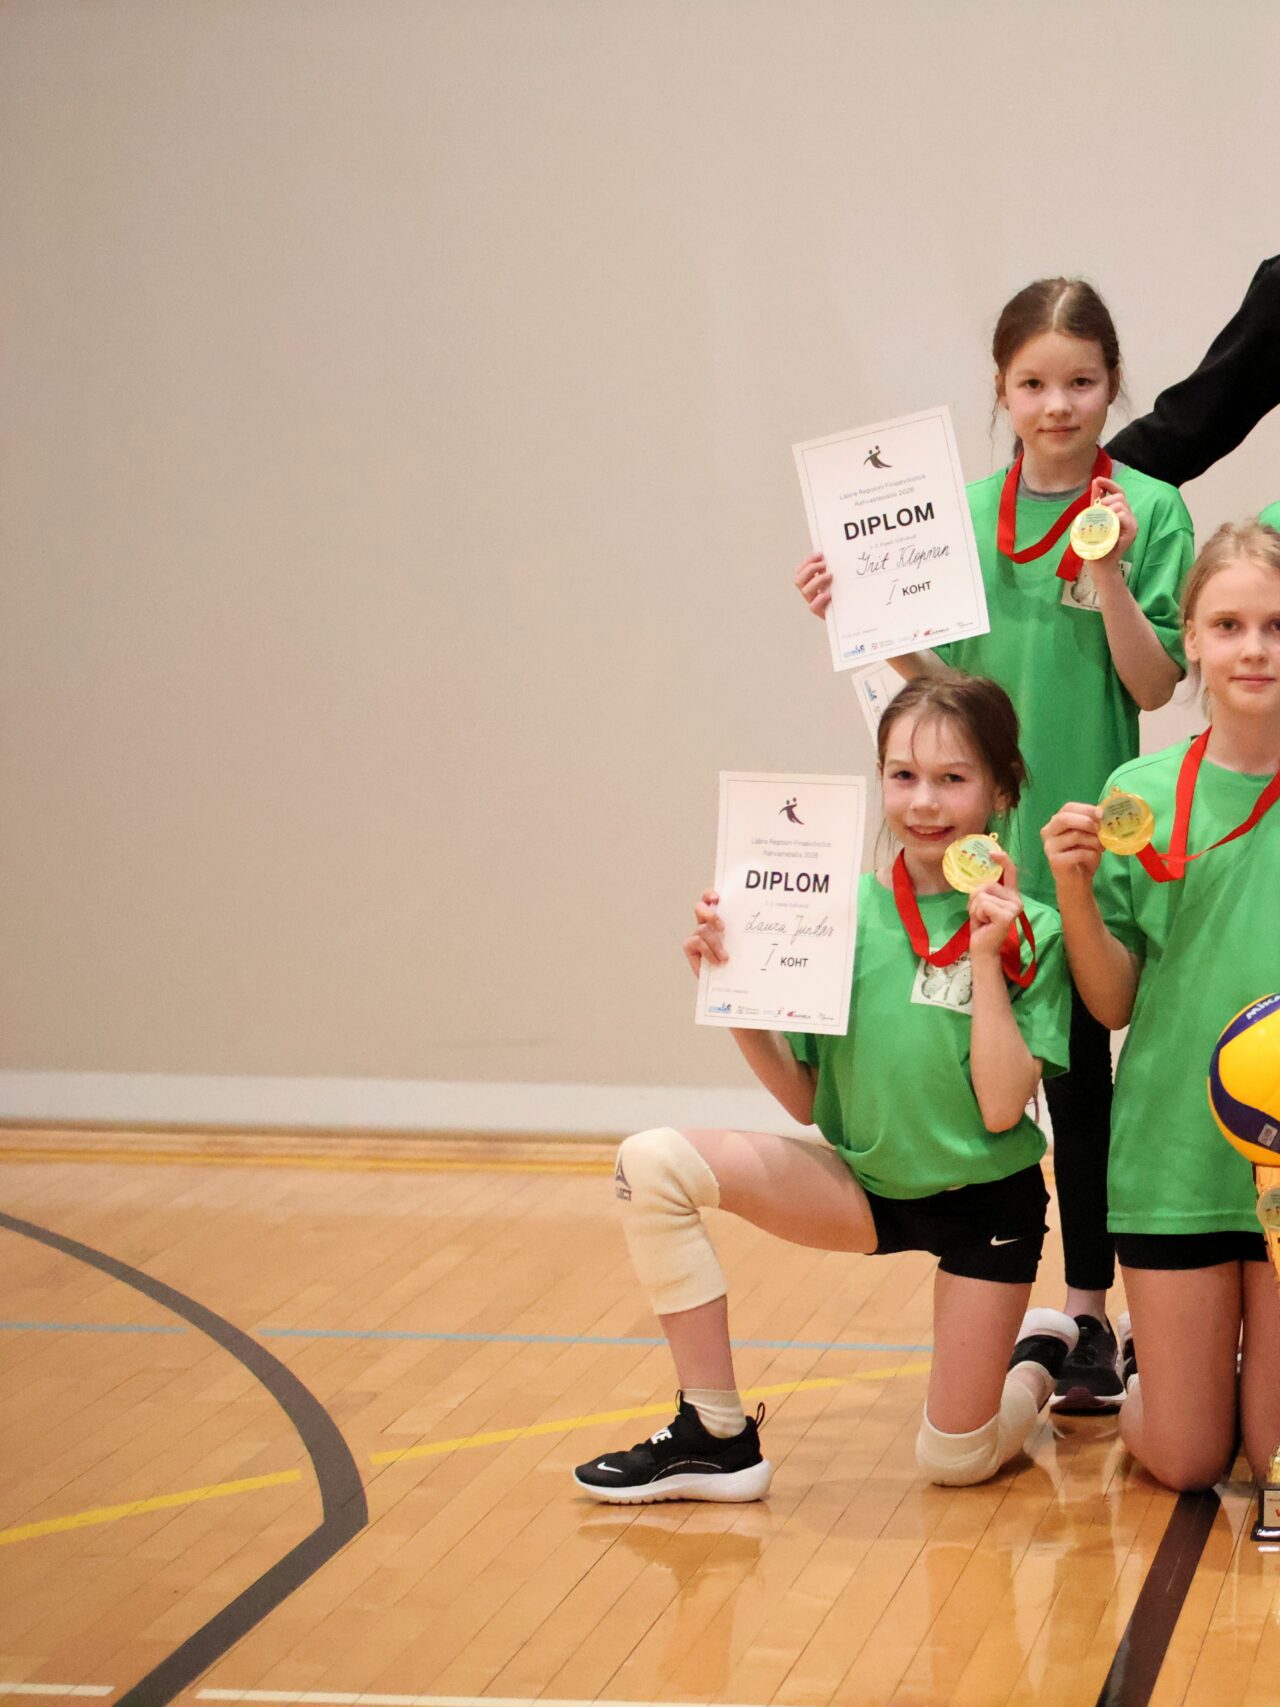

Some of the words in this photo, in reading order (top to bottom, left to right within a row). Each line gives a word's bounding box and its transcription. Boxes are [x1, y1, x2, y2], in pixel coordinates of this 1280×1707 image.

[844, 502, 935, 541] DIPLOM
[902, 581, 932, 596] KOHT
[745, 870, 830, 894] DIPLOM
[780, 956, 809, 968] KOHT
